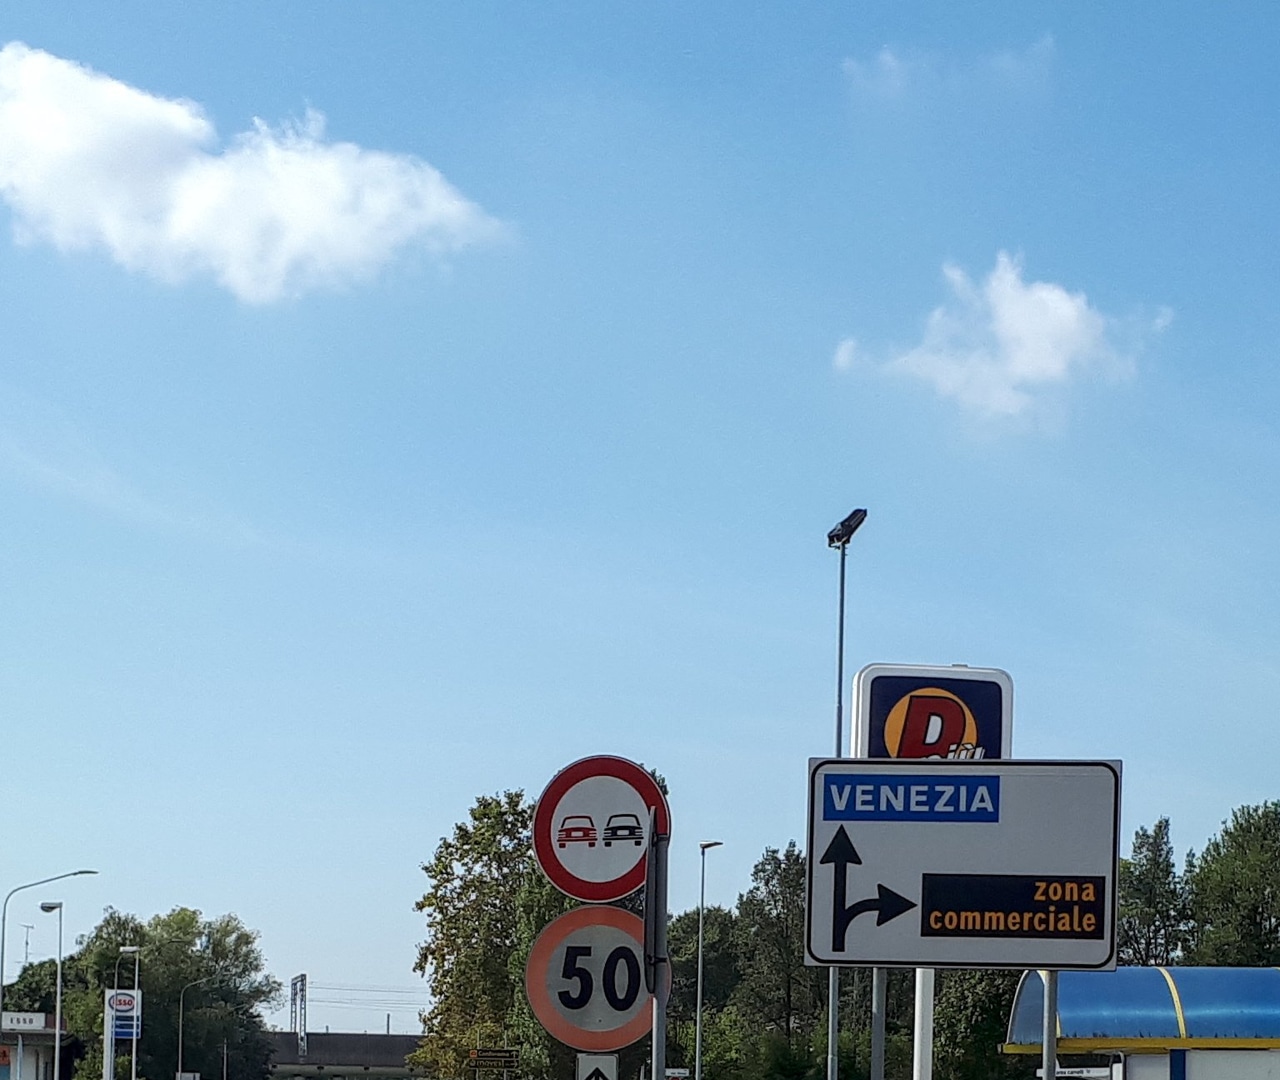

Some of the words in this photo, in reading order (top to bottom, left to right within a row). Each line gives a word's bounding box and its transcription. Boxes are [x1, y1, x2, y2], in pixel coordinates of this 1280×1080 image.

[829, 784, 995, 813] VENEZIA
[1033, 879, 1096, 902] zona
[929, 905, 1097, 932] commerciale
[557, 945, 641, 1012] 50
